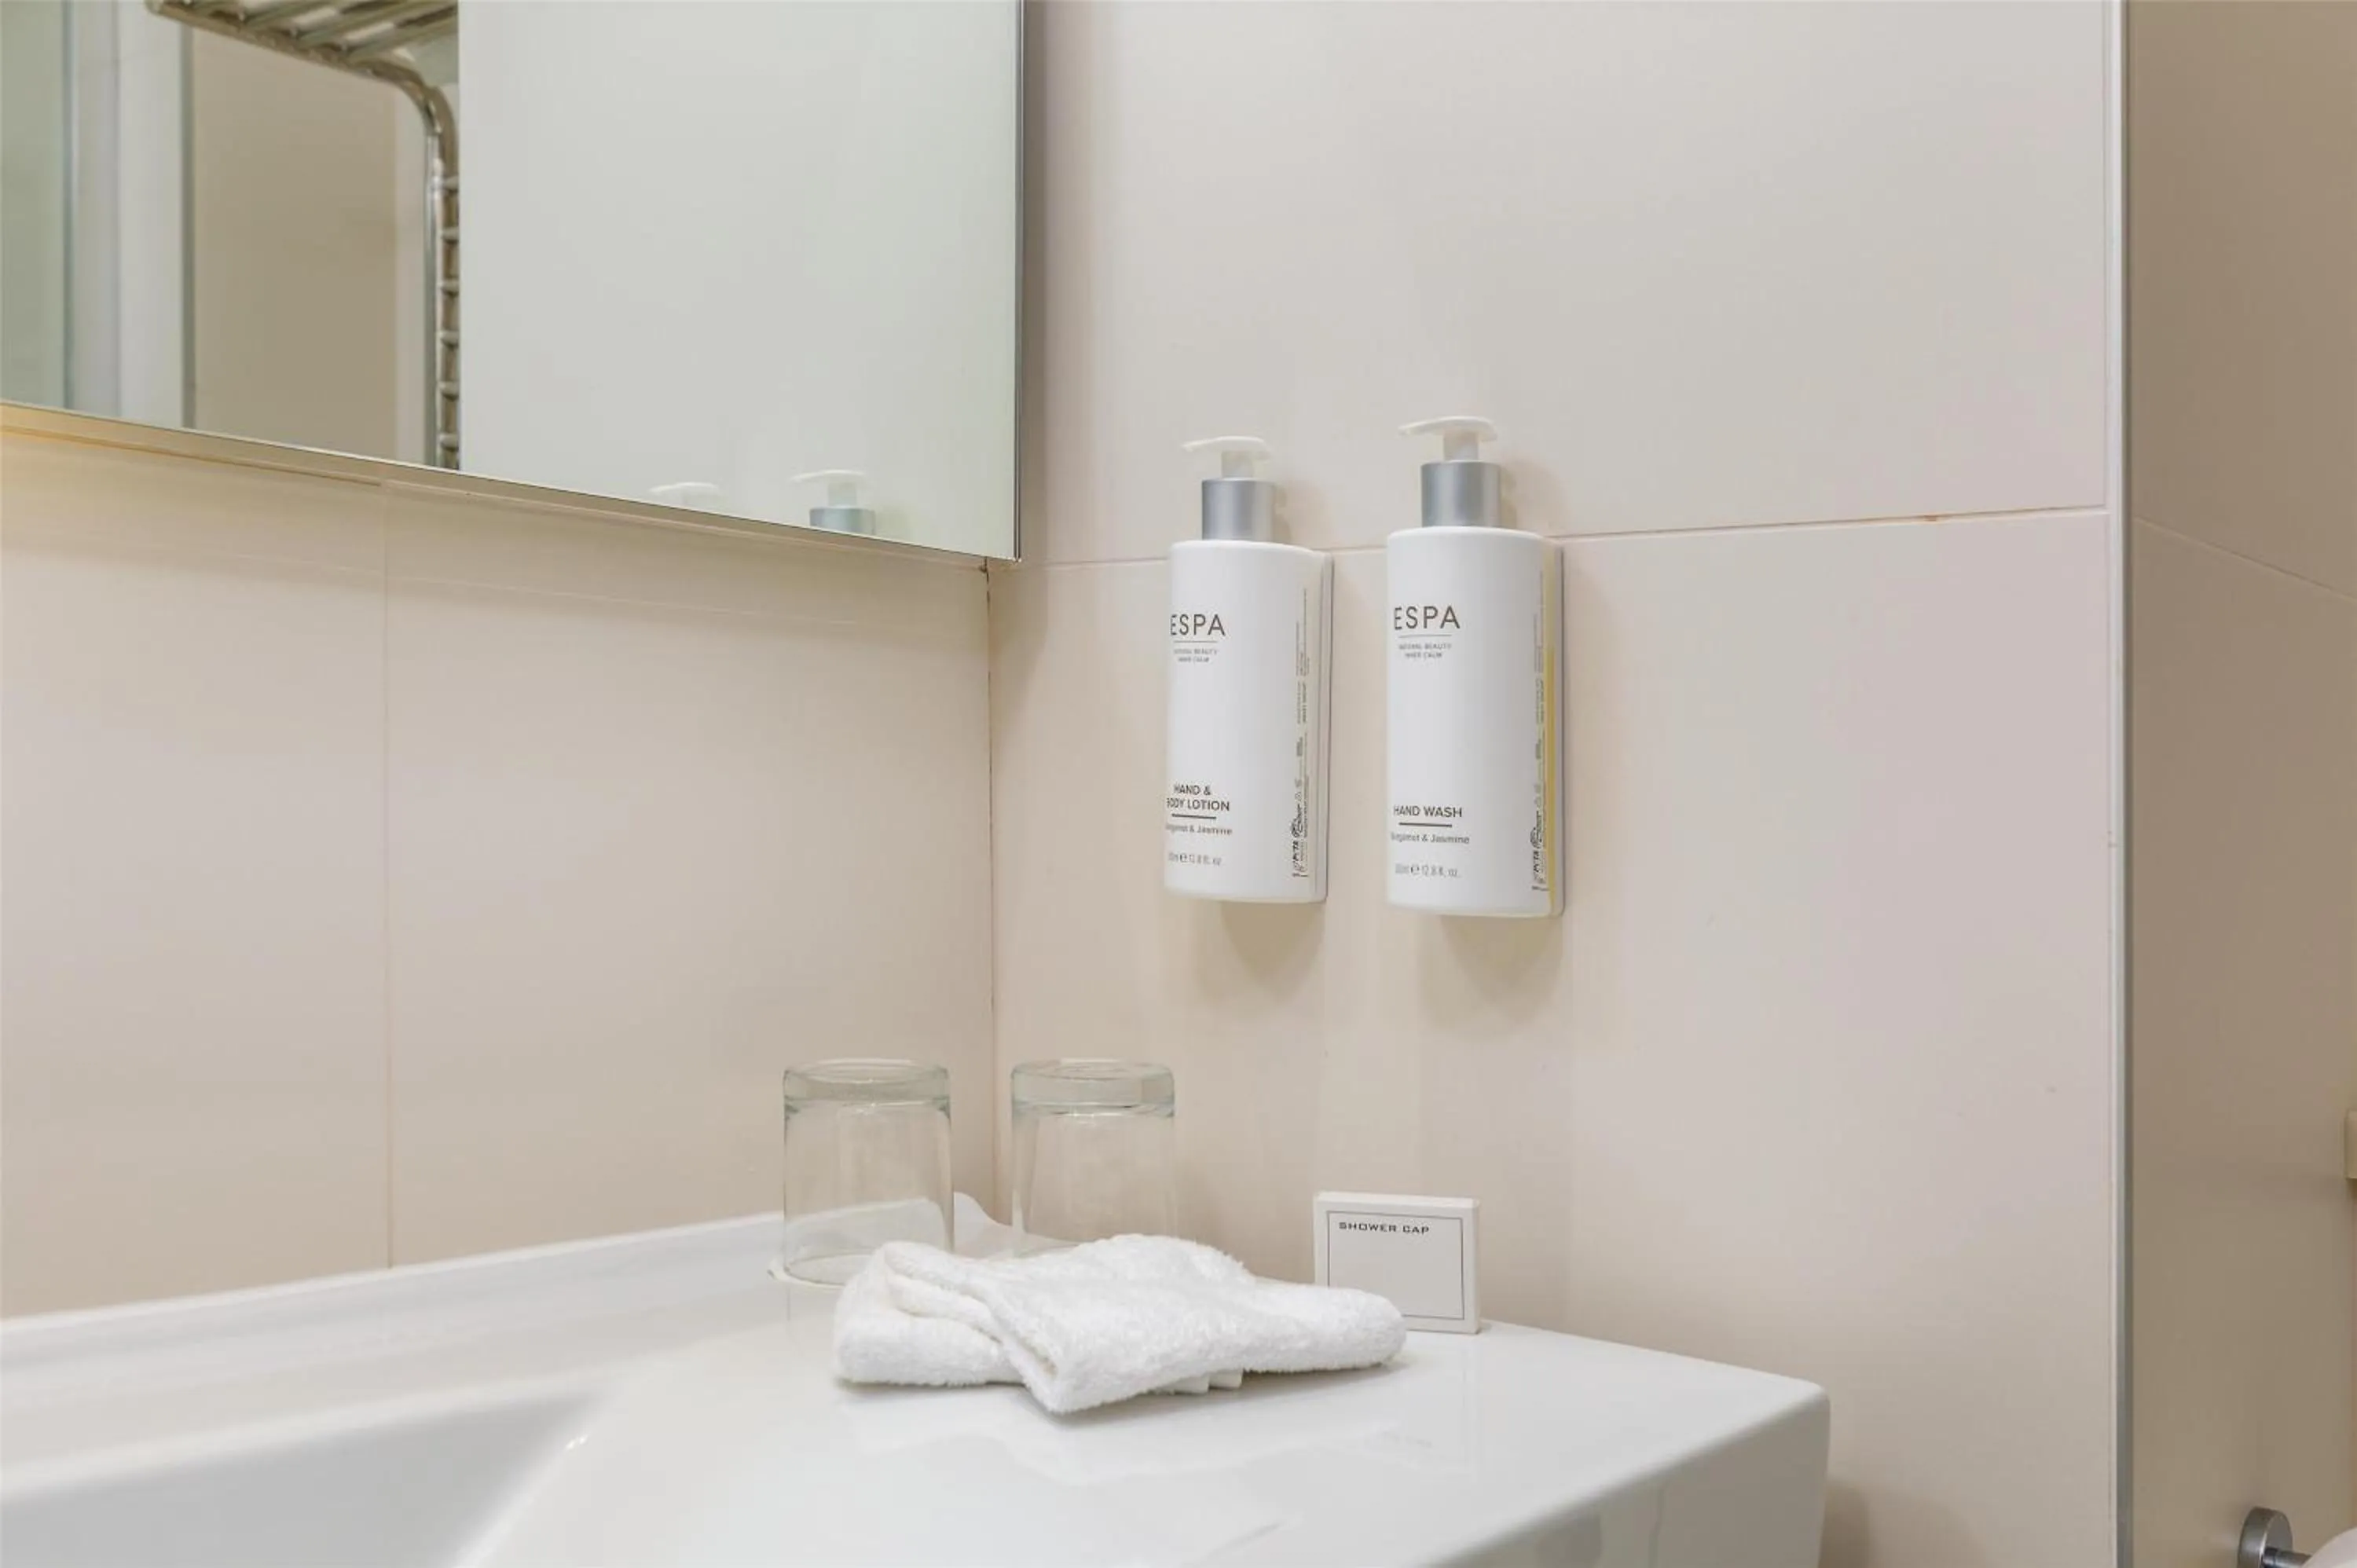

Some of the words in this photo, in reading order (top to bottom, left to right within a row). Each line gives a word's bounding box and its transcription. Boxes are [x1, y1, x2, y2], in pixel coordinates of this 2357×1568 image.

[1394, 605, 1461, 630] ESPA
[1170, 614, 1226, 636] ESPA
[1173, 784, 1200, 796] HAND
[1203, 785, 1211, 796] &
[1187, 799, 1230, 811] LOTION
[1393, 805, 1420, 816] HAND
[1423, 806, 1463, 818] WASH
[1430, 834, 1470, 844] Jasmine
[1339, 1222, 1397, 1233] SHOWER
[1402, 1225, 1430, 1235] CAP
